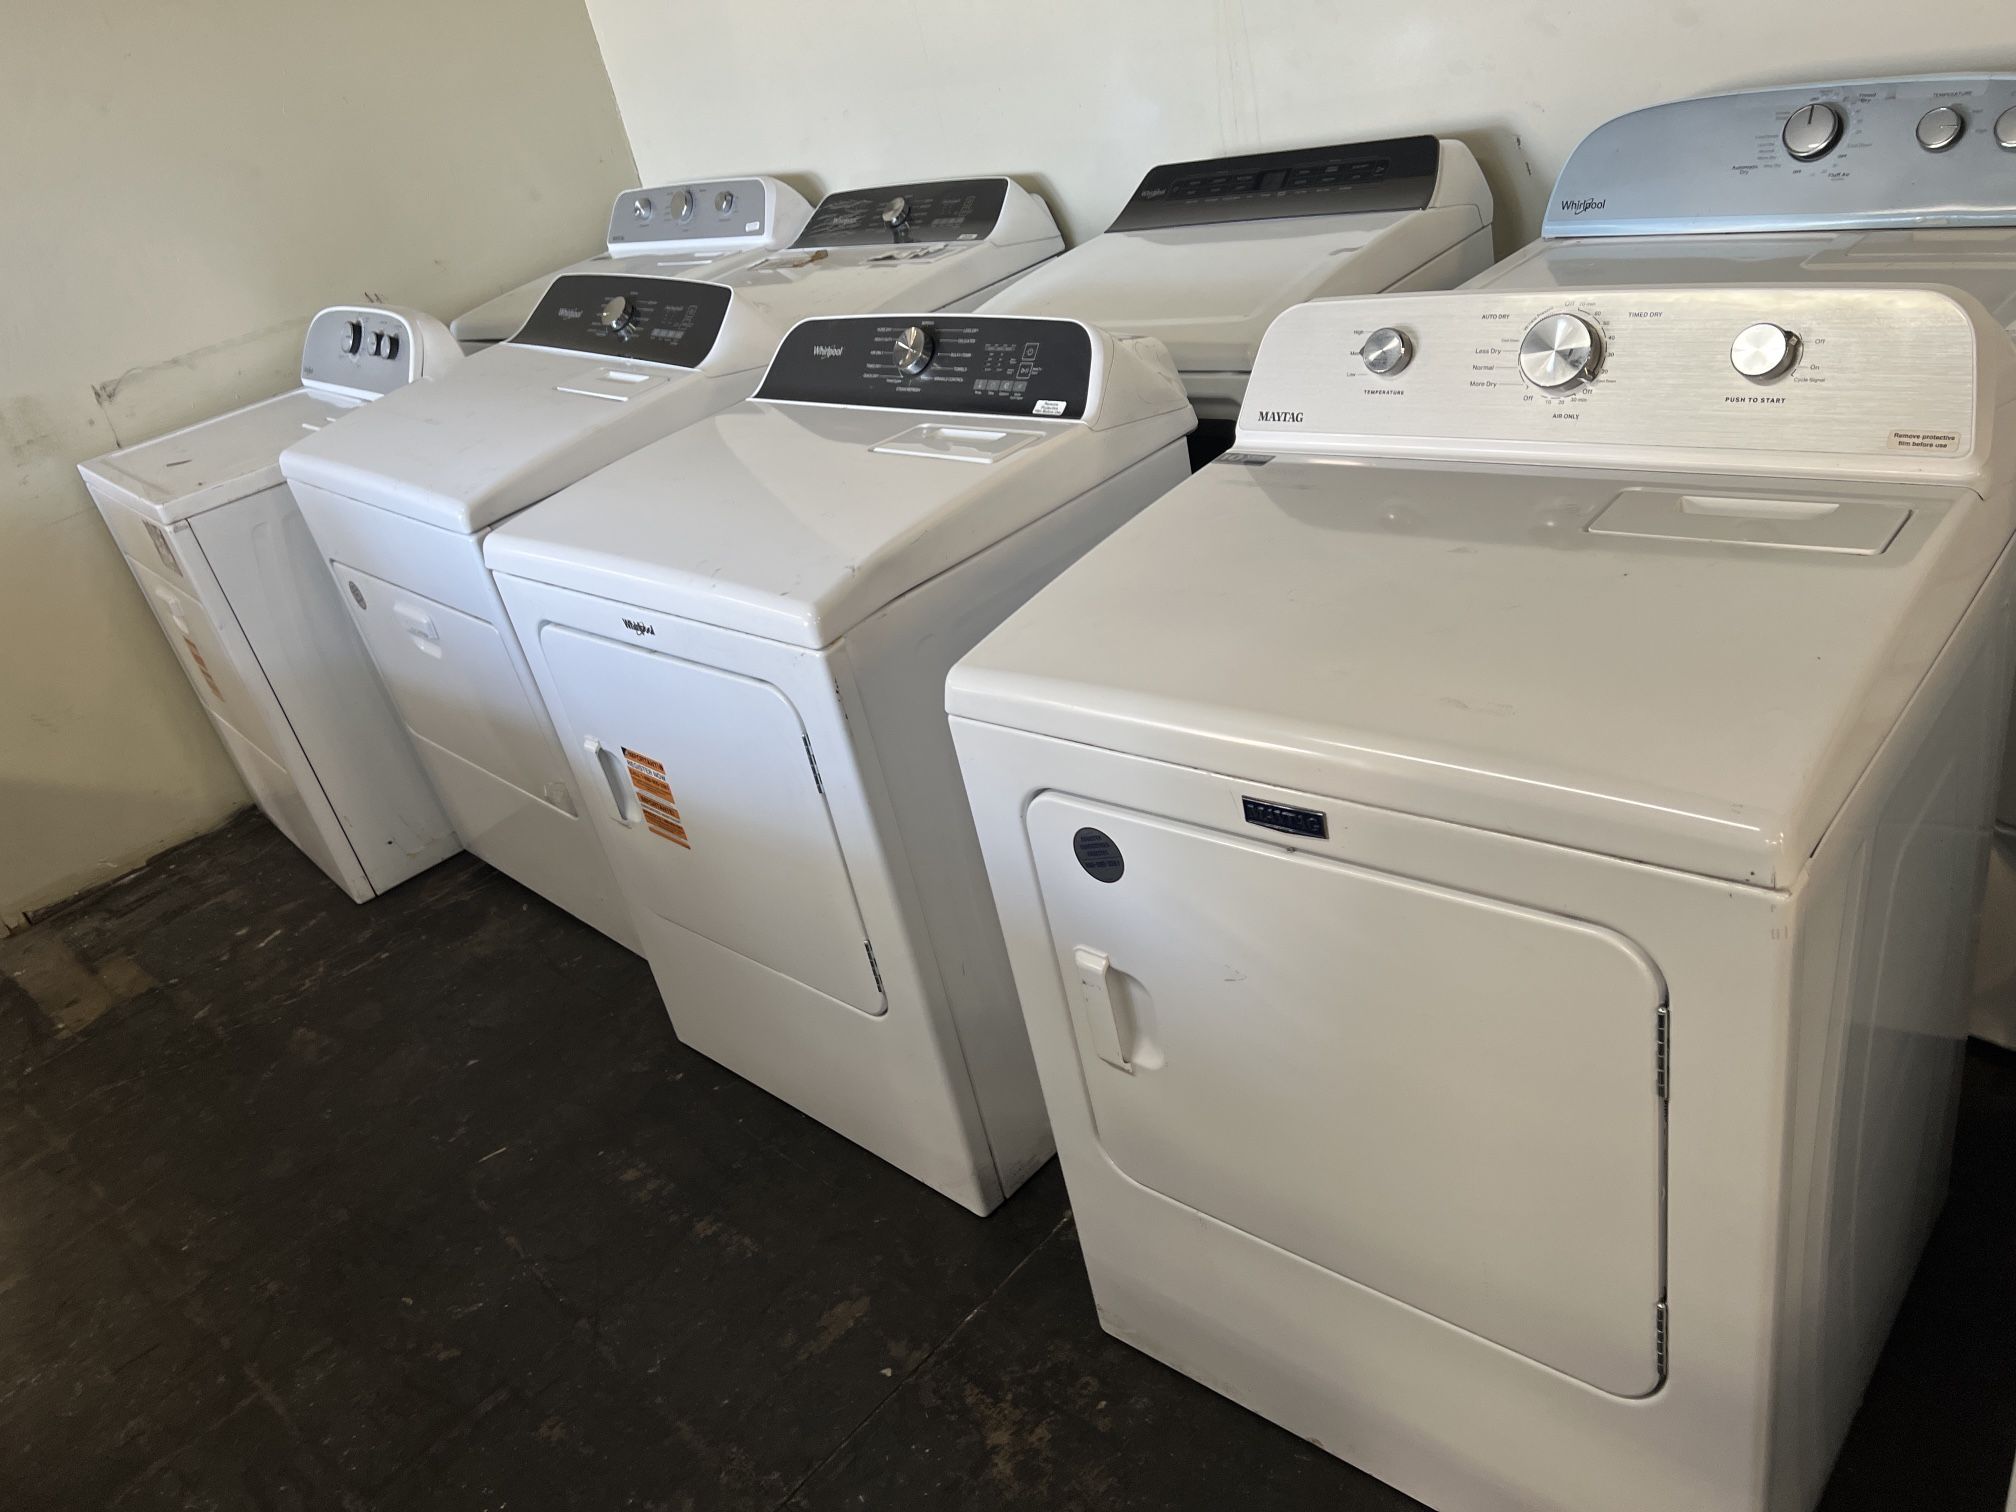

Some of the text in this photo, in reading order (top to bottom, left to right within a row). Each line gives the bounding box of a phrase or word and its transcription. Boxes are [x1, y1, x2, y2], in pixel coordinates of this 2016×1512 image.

[1562, 198, 1606, 215] Whirlpool
[1484, 381, 1498, 389] Dry
[1257, 410, 1304, 424] MAYTAG
[1894, 432, 1921, 440] Remove
[621, 618, 656, 636] Whirlpool
